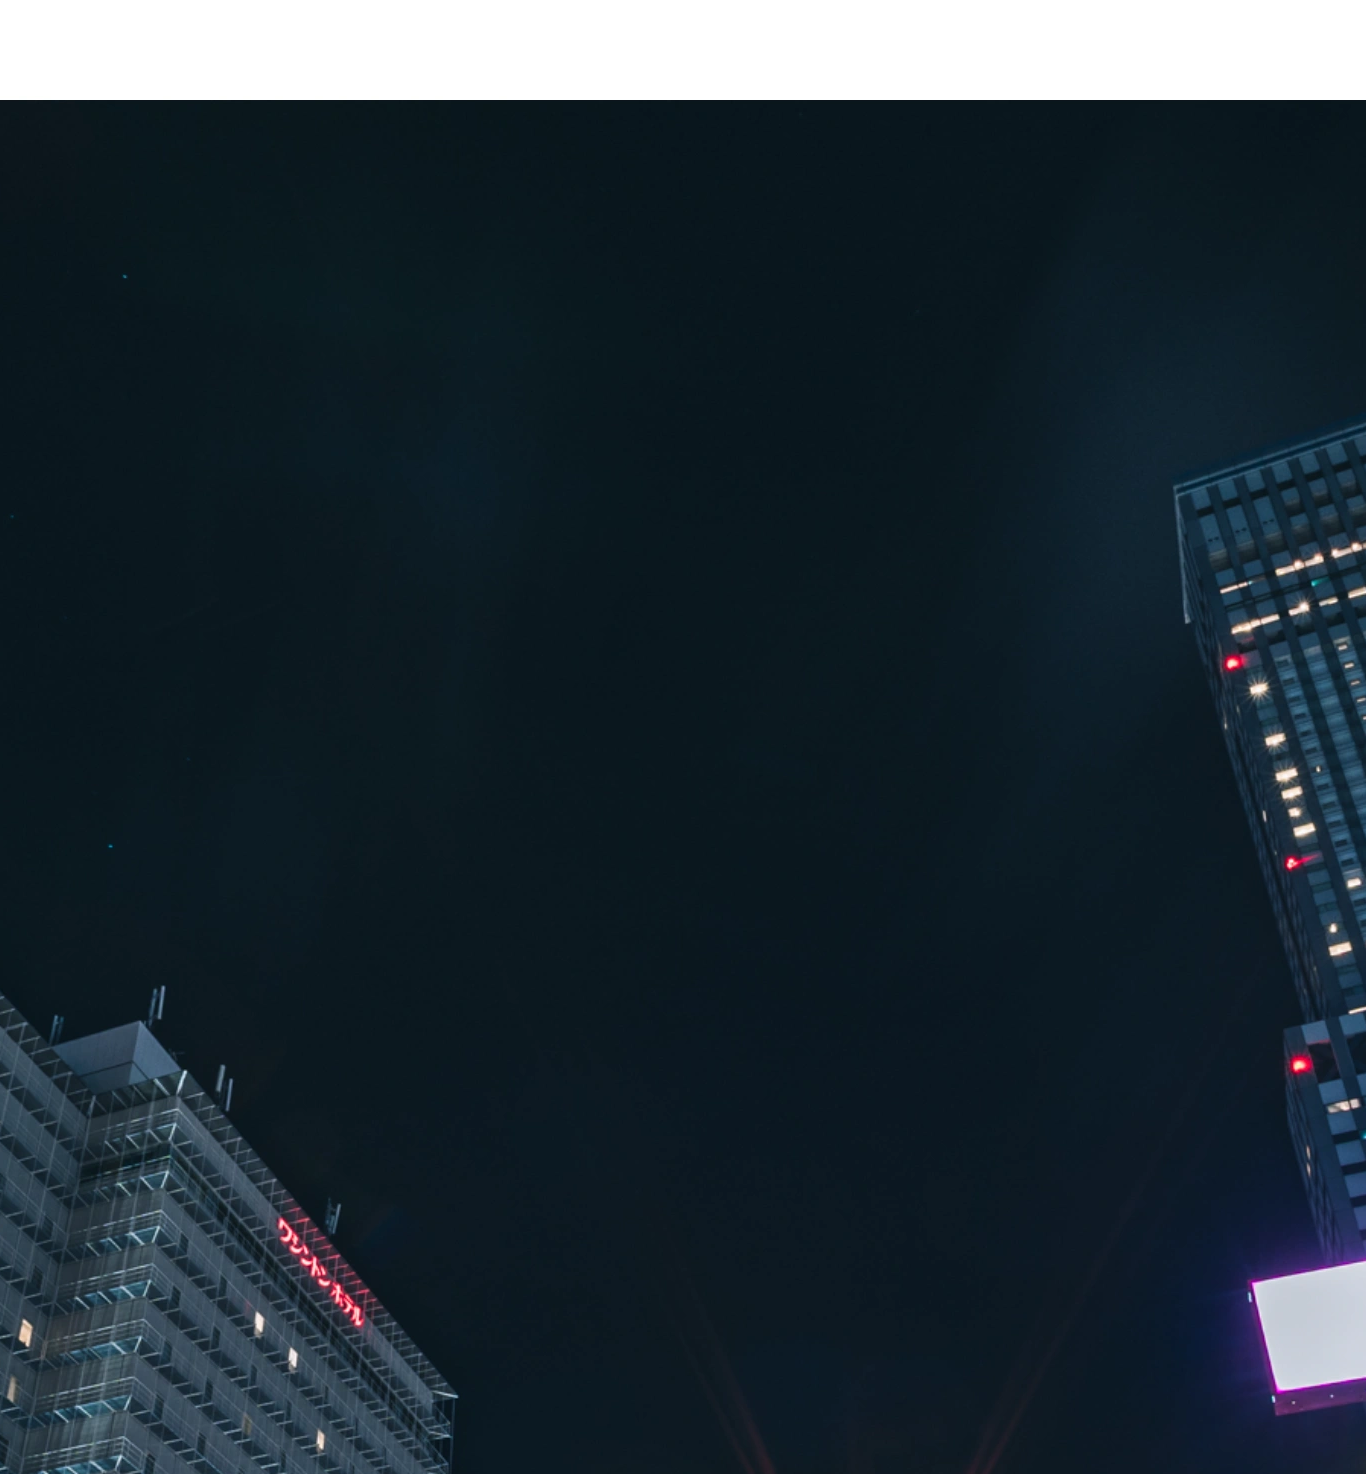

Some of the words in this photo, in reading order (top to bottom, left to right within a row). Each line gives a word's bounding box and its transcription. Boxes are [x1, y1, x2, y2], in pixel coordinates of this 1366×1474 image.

[278, 1217, 364, 1327] ワシントンホテル
